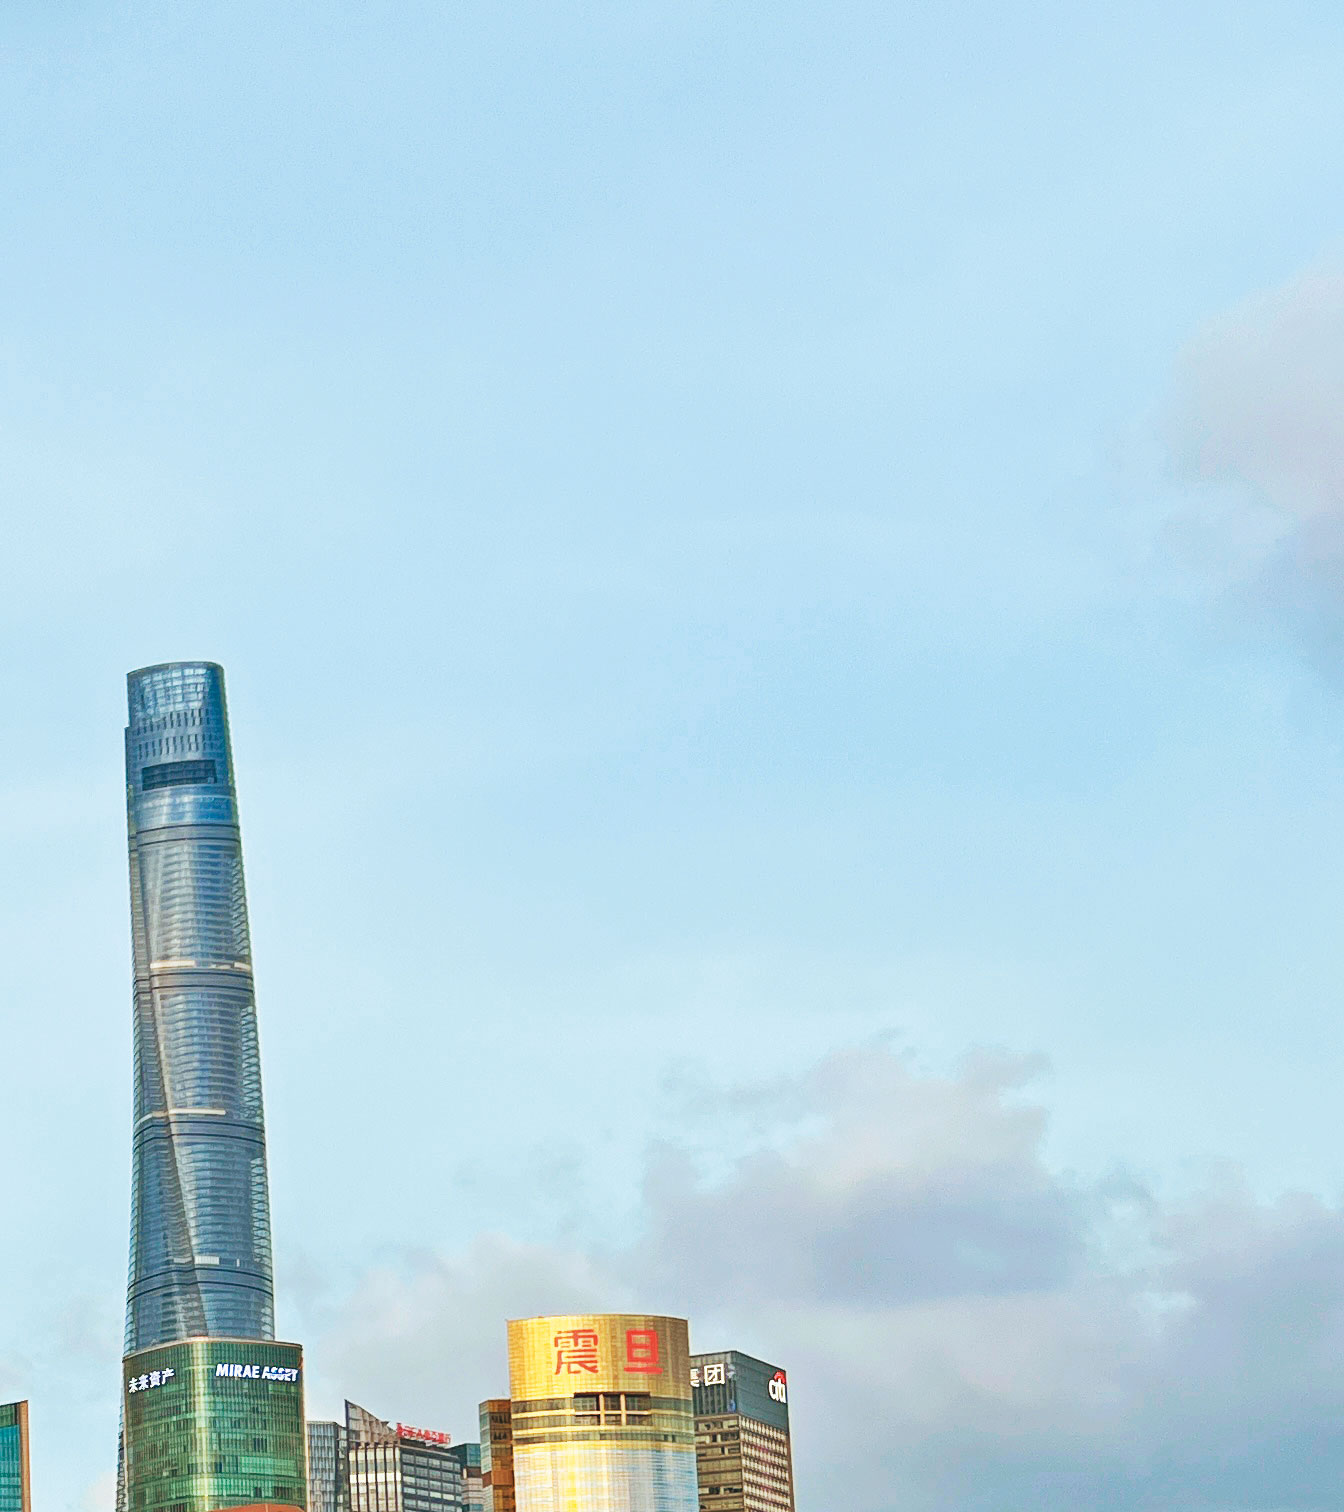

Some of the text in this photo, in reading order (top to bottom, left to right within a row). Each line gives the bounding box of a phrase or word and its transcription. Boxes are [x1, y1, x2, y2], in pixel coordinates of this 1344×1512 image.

[553, 1329, 663, 1375] 震旦
[216, 1363, 299, 1382] MIRAE ASSET
